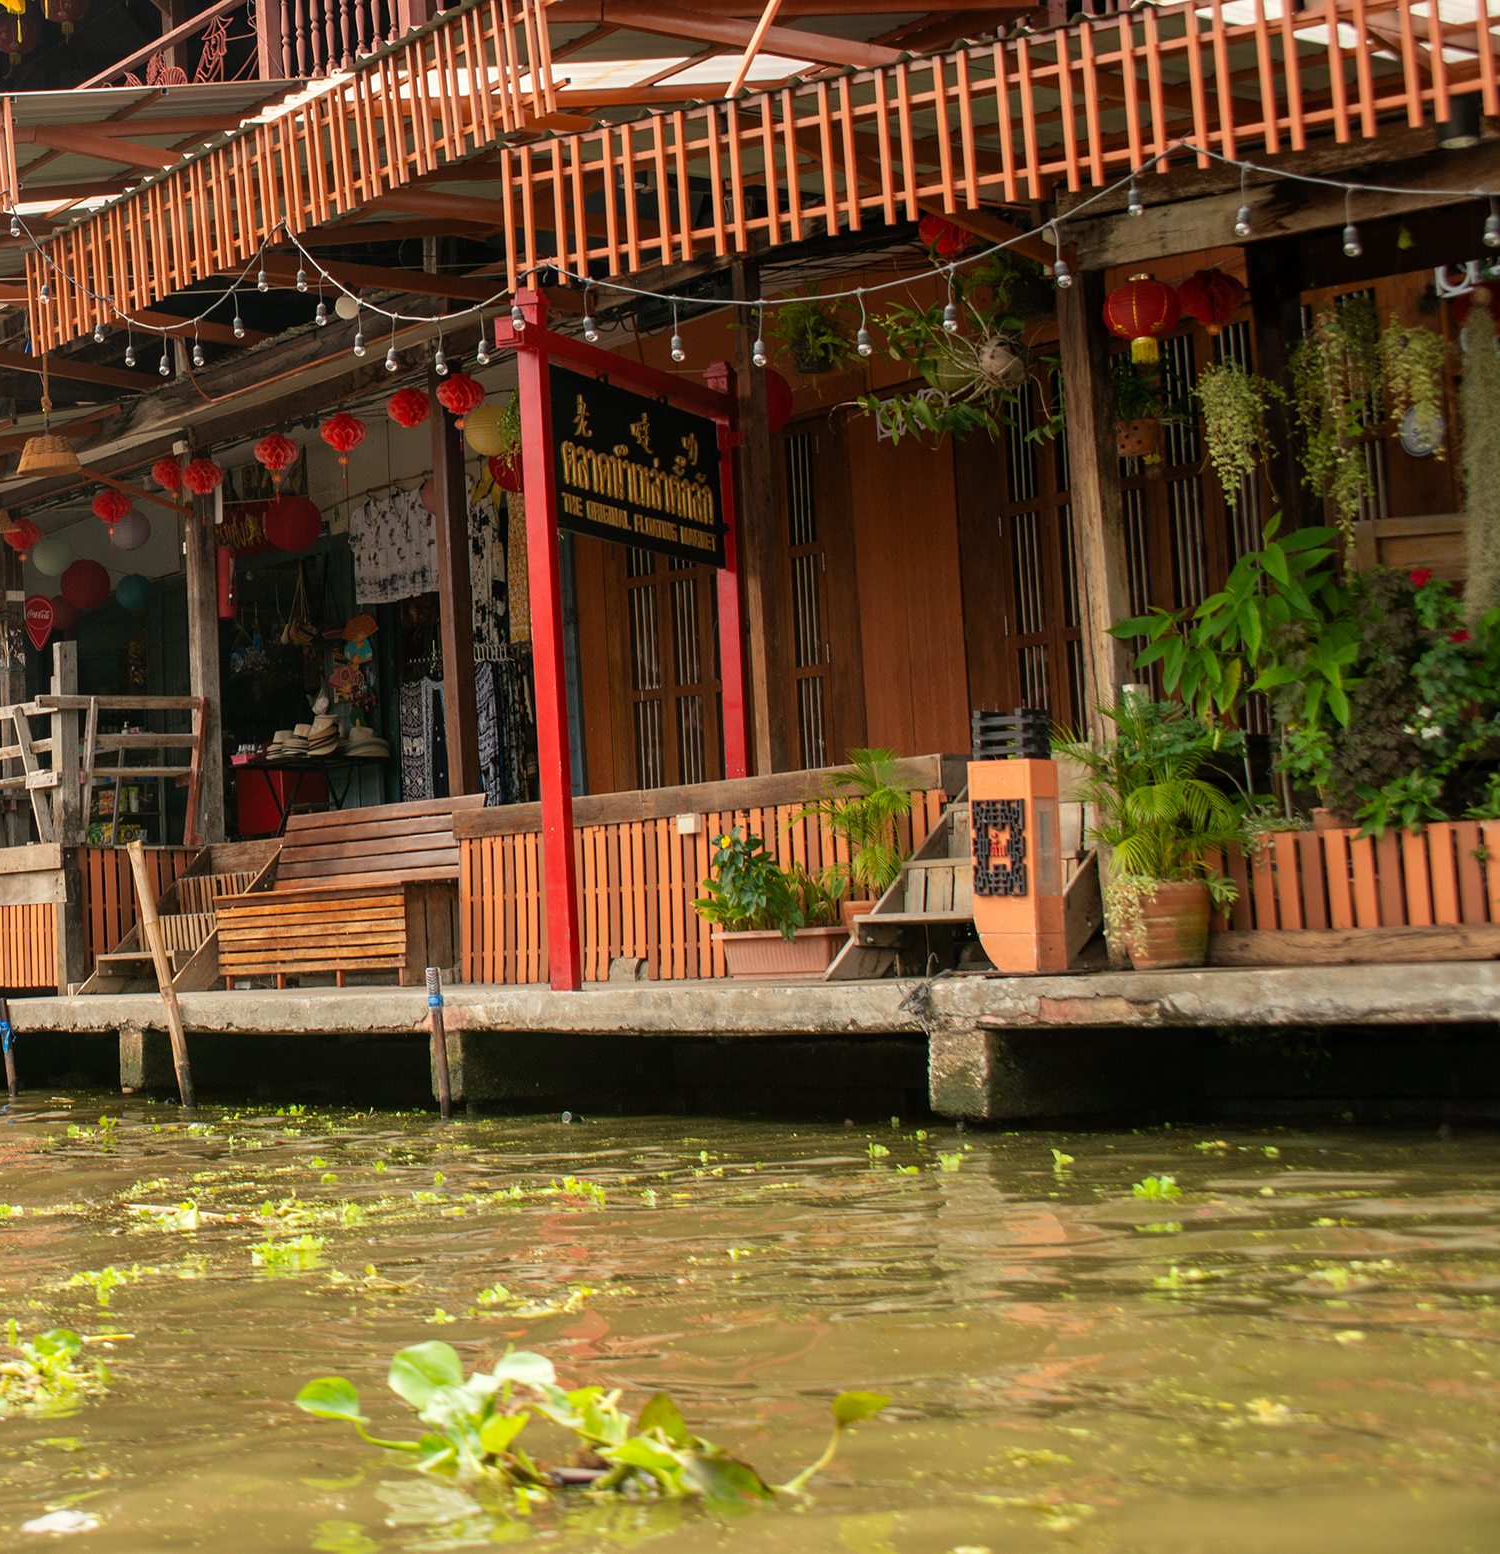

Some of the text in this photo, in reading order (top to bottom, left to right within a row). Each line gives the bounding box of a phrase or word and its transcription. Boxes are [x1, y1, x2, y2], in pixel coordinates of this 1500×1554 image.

[561, 491, 717, 552] THE ORIGINAL FLOATING MARKET
